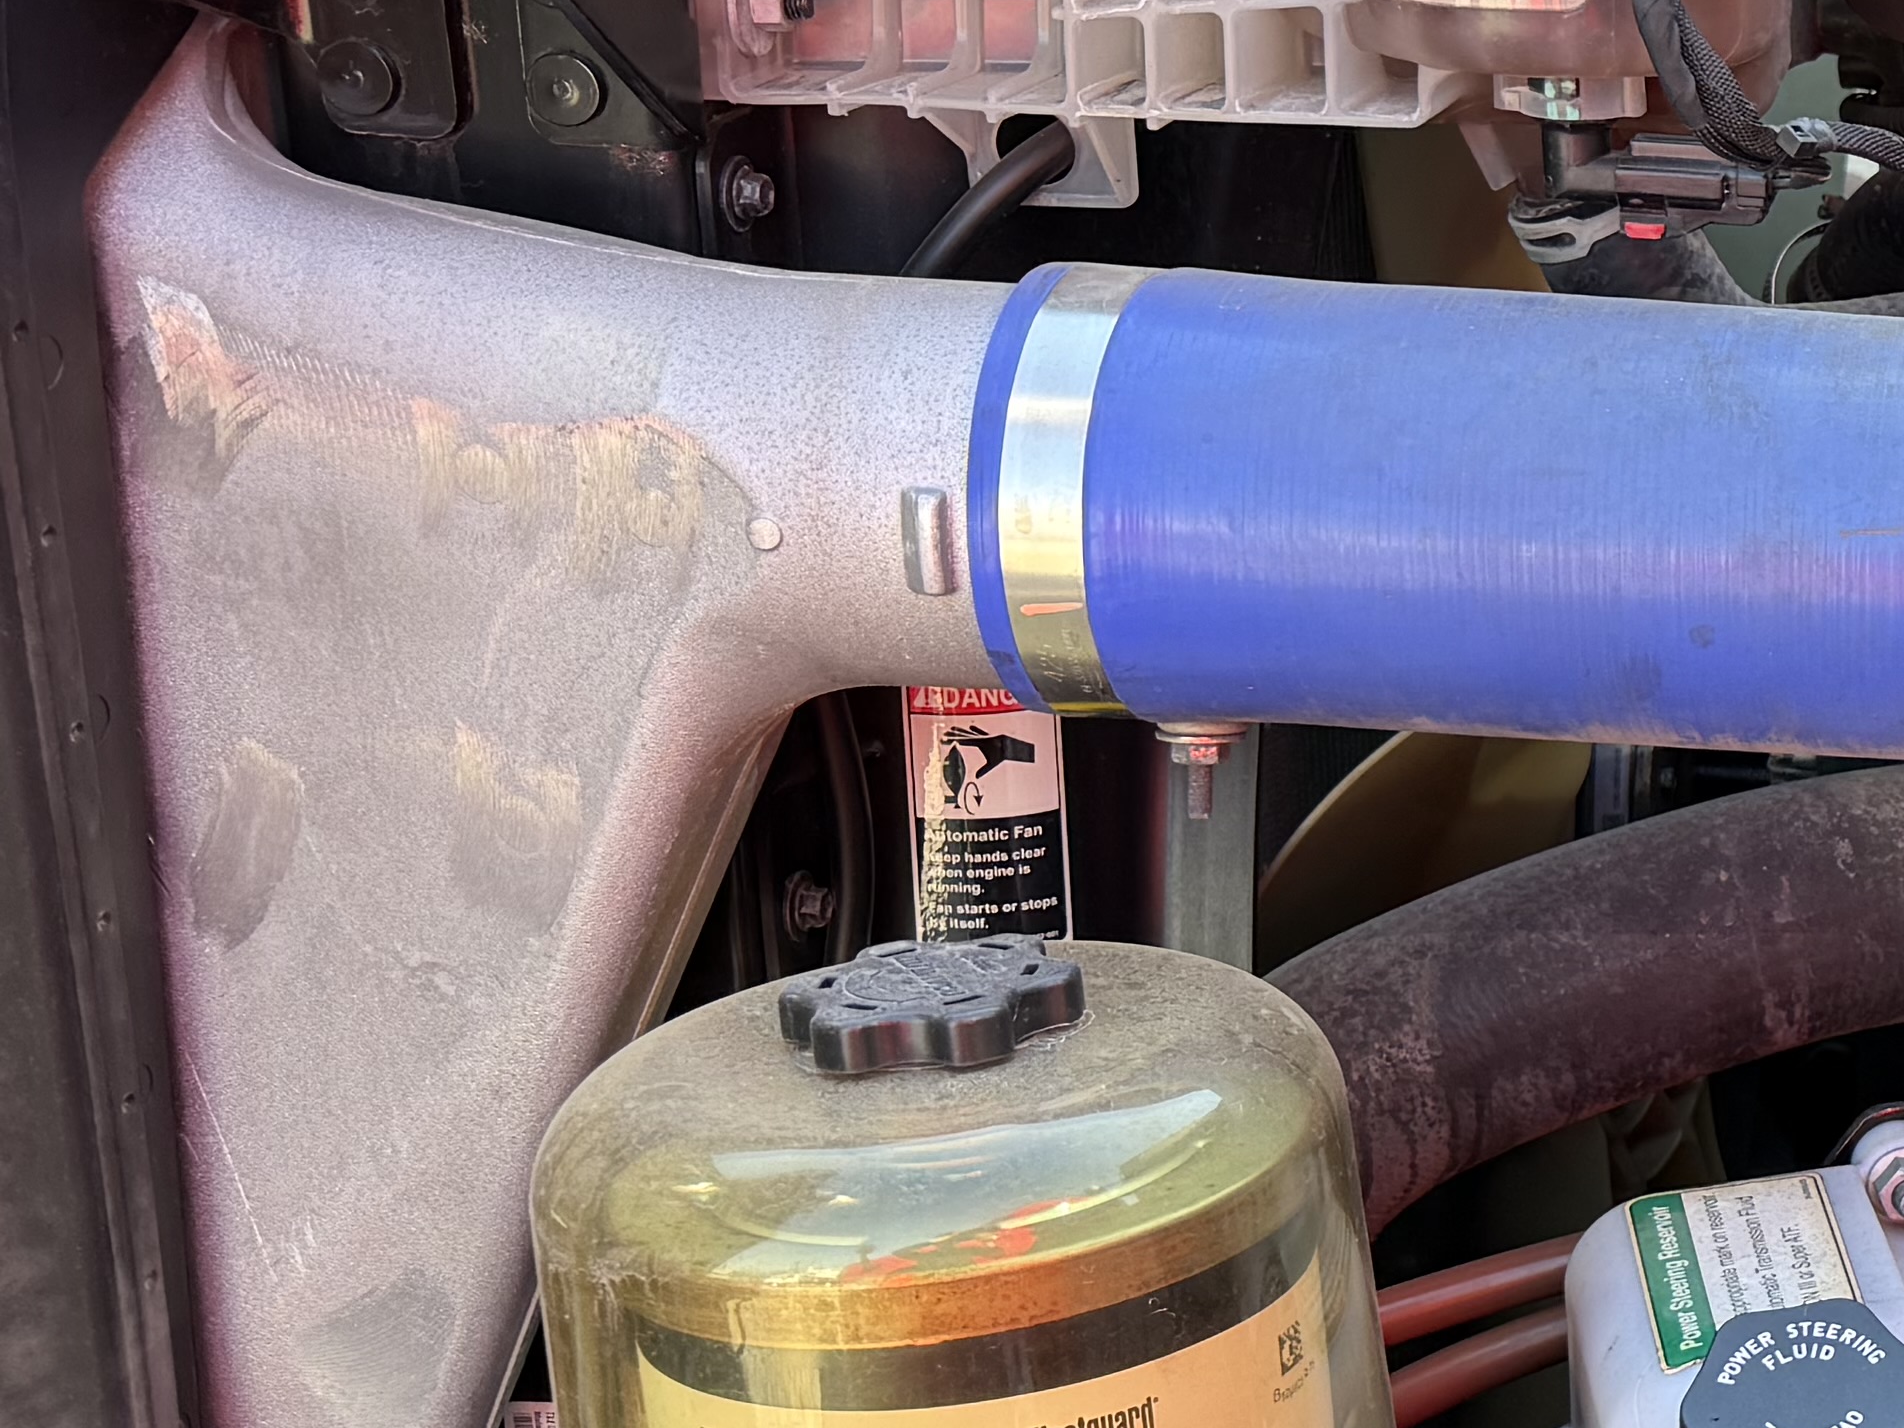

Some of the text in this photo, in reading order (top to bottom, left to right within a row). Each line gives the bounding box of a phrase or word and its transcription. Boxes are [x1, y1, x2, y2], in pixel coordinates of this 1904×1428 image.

[924, 824, 1043, 843] Automatic Fan
[926, 847, 1046, 865] Keep hands clear
[966, 866, 1015, 880] engine
[1019, 864, 1031, 875] is
[926, 882, 985, 896] running.
[929, 895, 1058, 914] Fan starts or stops
[950, 916, 989, 930] itself.
[1735, 1195, 1775, 1274] Transmission Fluid
[1714, 1231, 1734, 1269] mark on
[1792, 1244, 1811, 1269] Super
[1648, 1206, 1703, 1351] Power Steering Reservoir
[1717, 1321, 1886, 1385] POWER STEERING
[1761, 1342, 1836, 1371] FLUID
